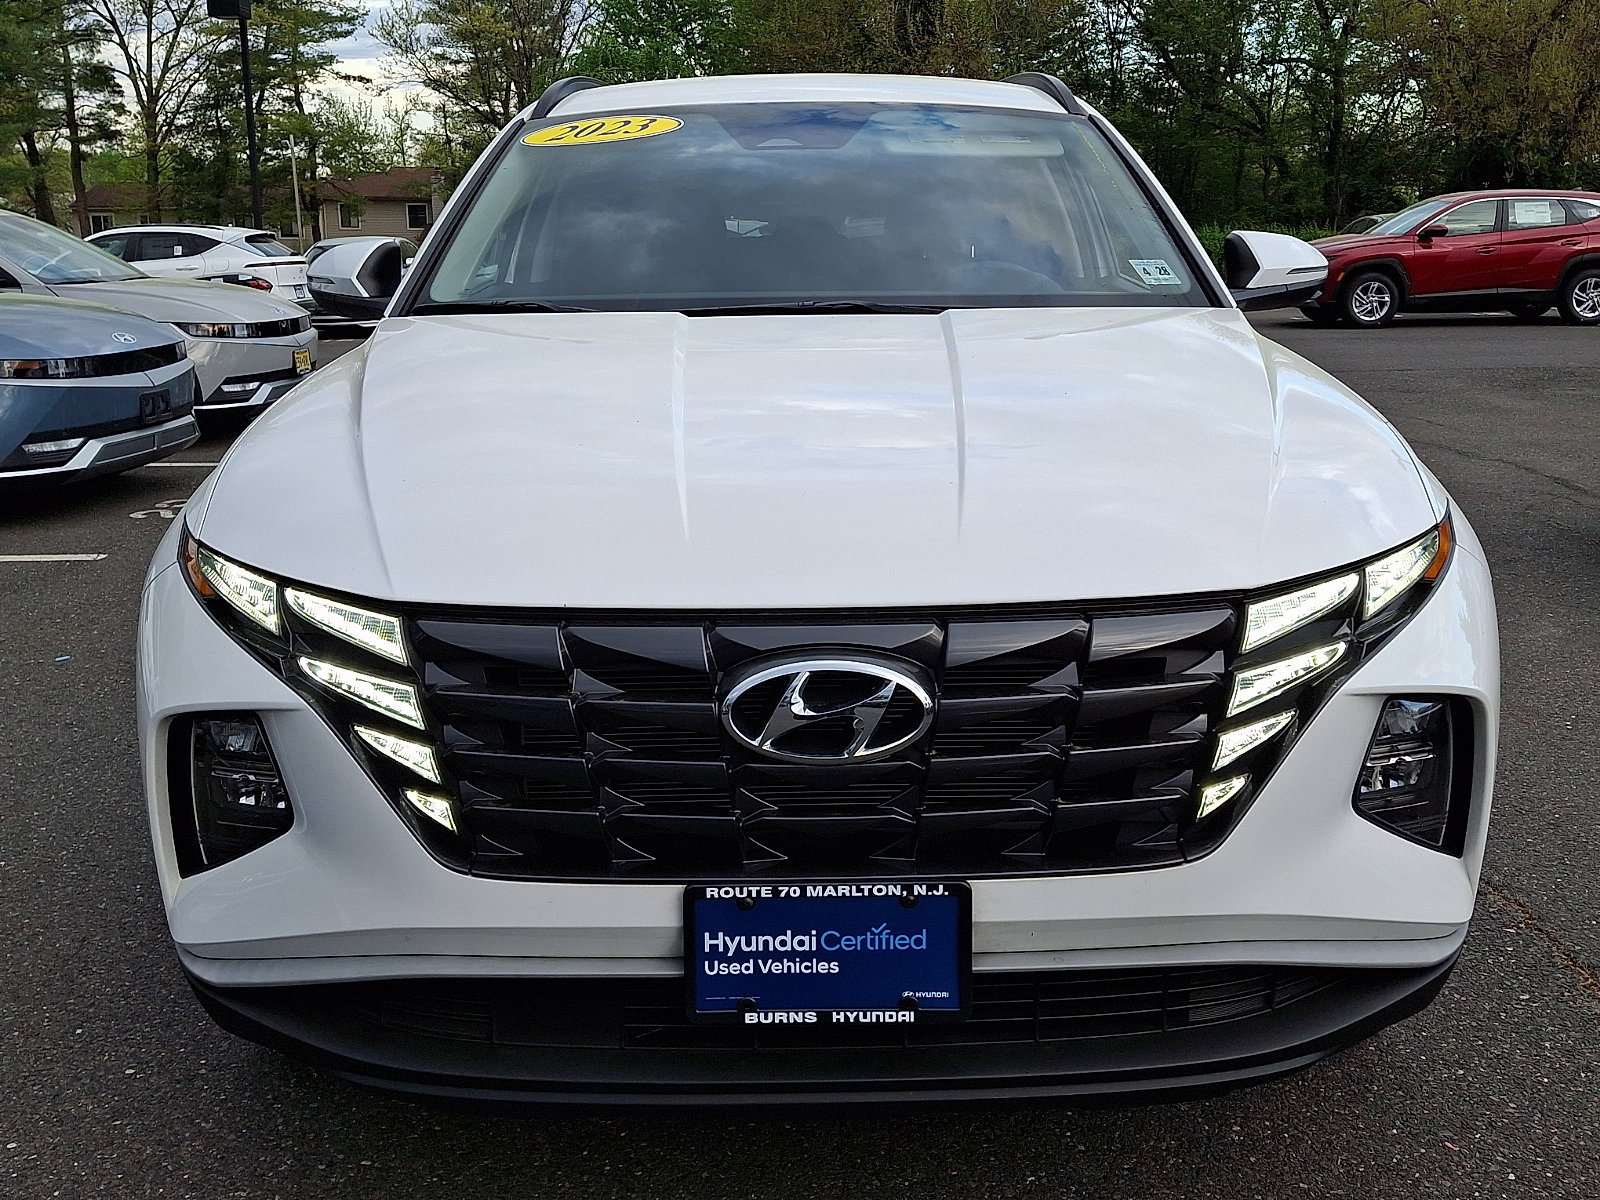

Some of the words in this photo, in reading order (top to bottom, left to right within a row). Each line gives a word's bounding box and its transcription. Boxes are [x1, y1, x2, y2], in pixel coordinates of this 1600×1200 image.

[544, 118, 658, 143] 2023
[1142, 267, 1151, 276] 4
[1155, 266, 1170, 275] 28
[706, 886, 773, 899] ROUTE
[778, 886, 801, 898] 70
[806, 884, 907, 898] MARLTON,
[913, 884, 949, 896] N.J.
[704, 930, 817, 957] Hyundai
[820, 922, 927, 951] Certified
[704, 959, 754, 976] Used
[757, 958, 840, 975] Vehicles
[915, 991, 949, 999] HYUNDAI
[744, 1011, 818, 1024] BURNS
[832, 1010, 915, 1023] HYUNDAI
